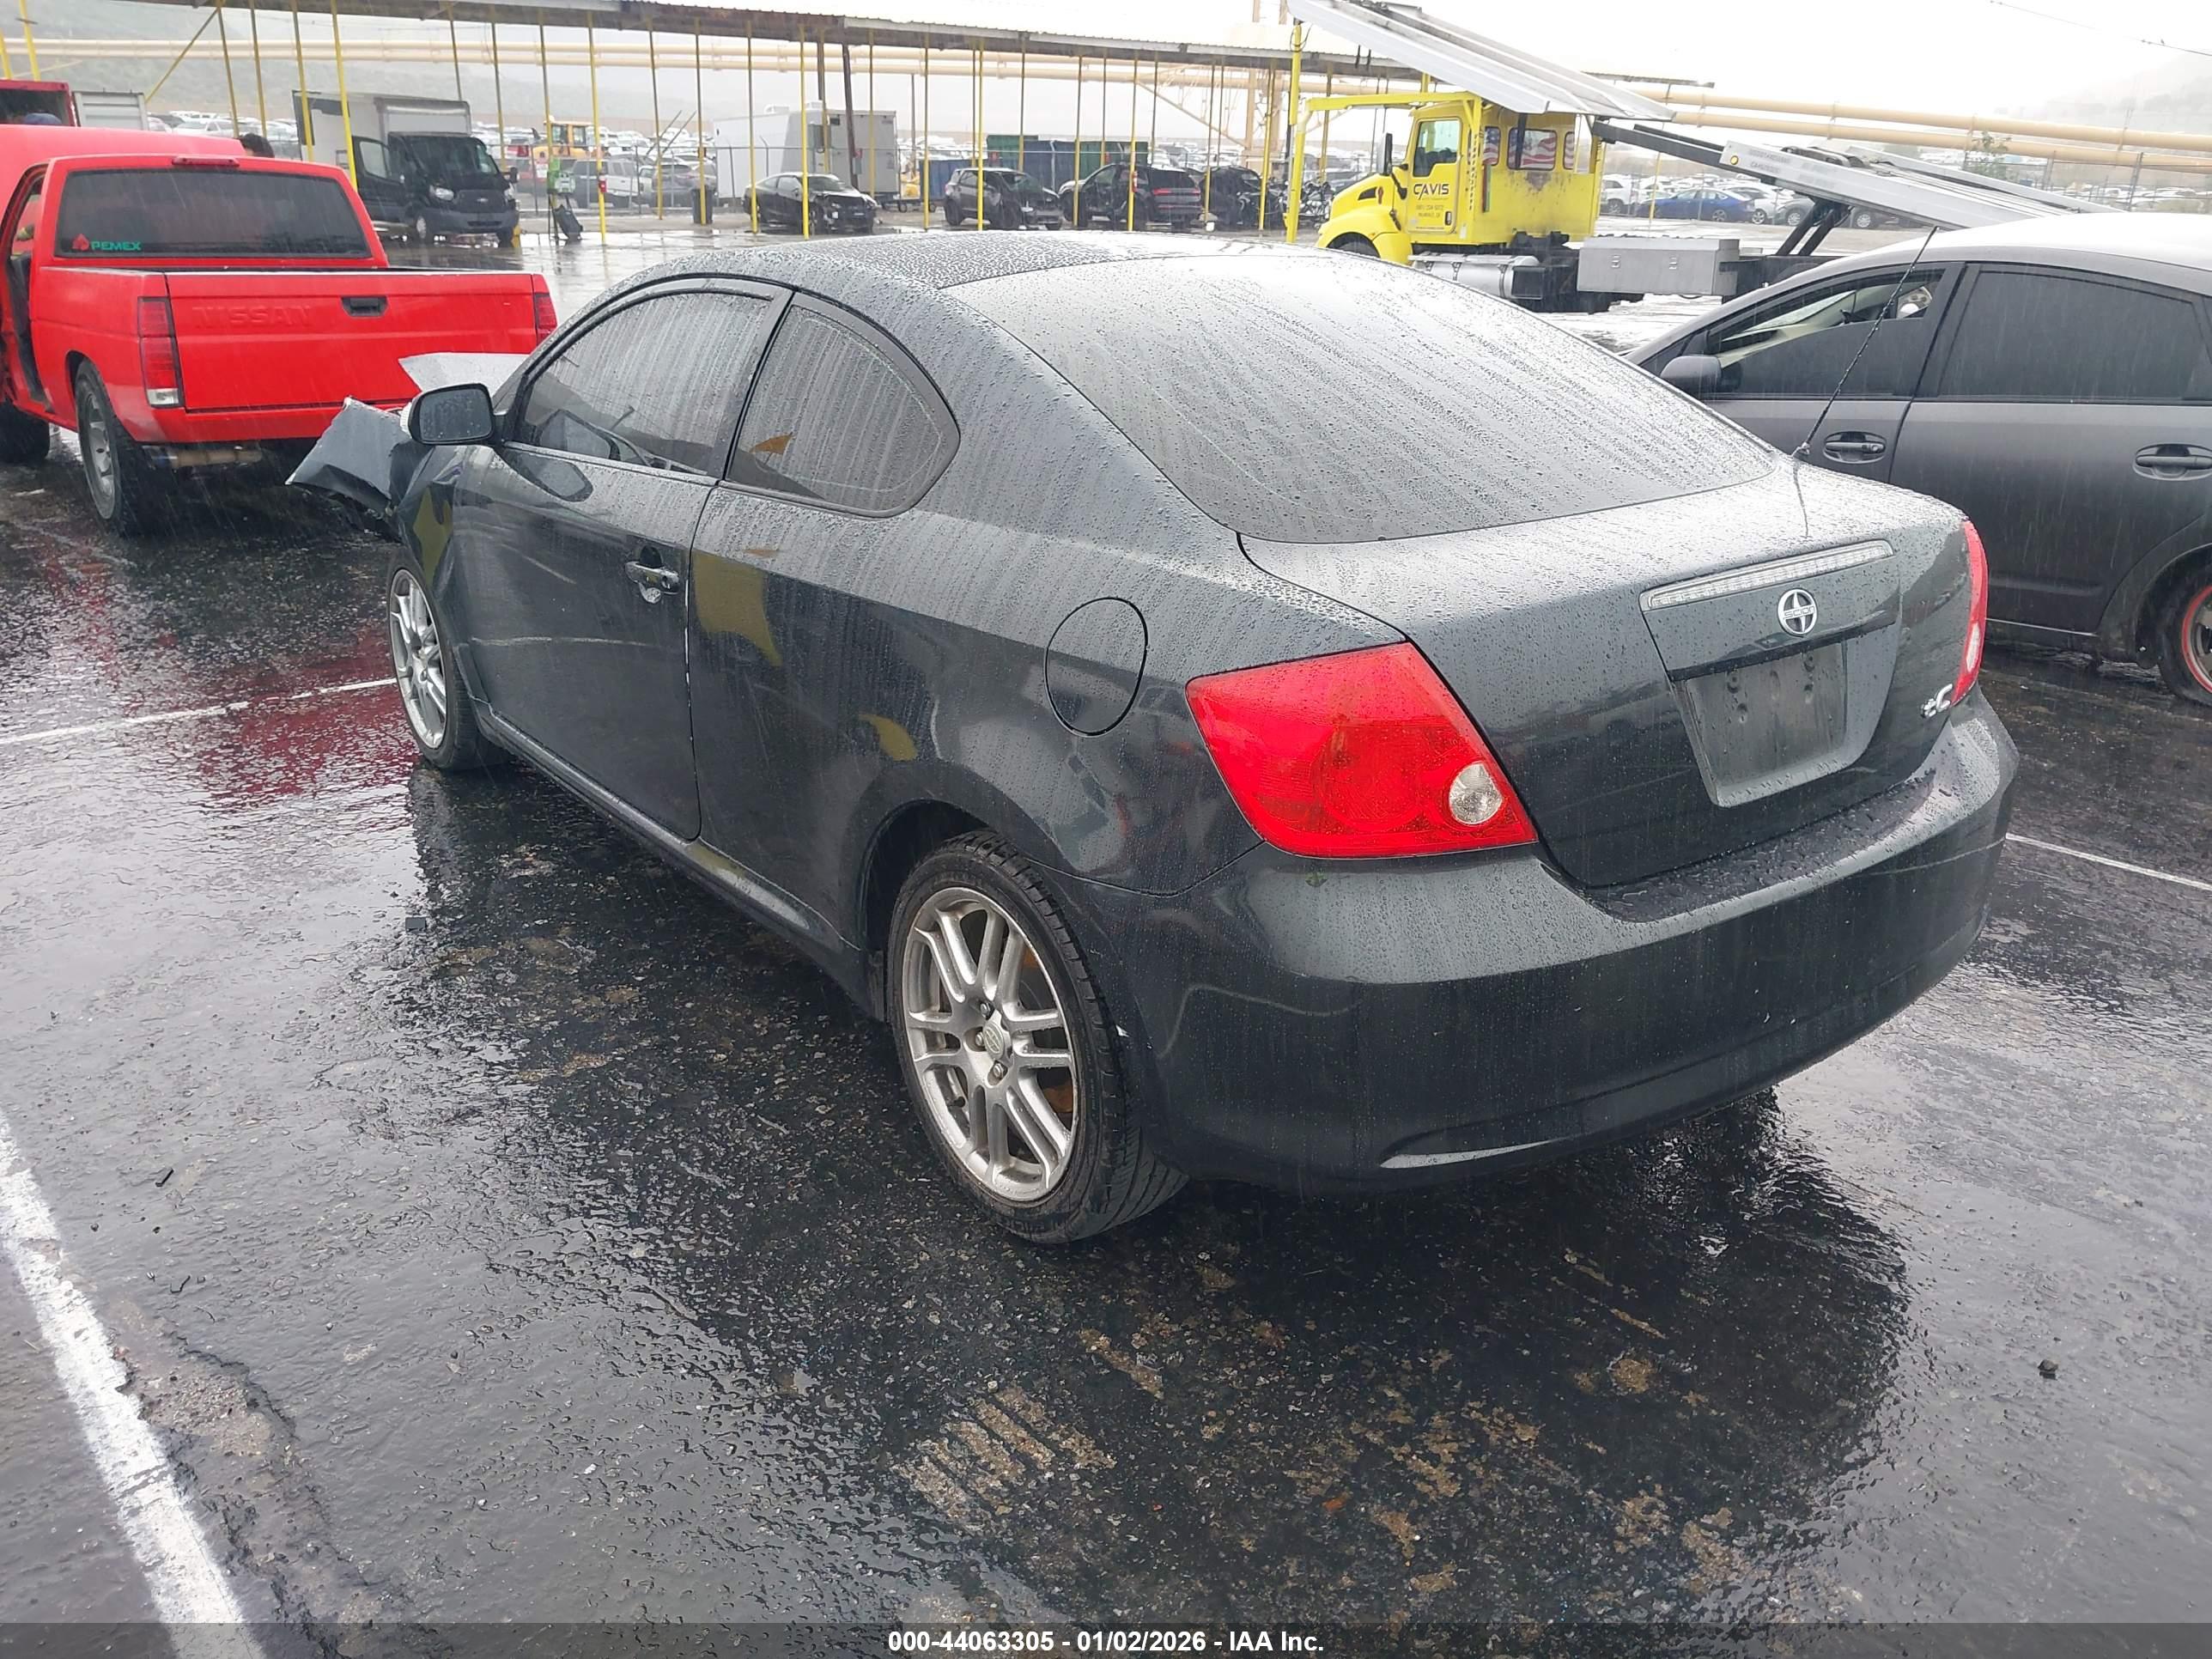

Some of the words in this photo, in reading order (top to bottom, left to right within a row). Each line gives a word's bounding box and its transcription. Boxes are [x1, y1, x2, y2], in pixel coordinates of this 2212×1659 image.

[1413, 183, 1449, 200] CAVIS
[91, 241, 142, 251] PEMEX
[191, 306, 313, 327] NISSAN
